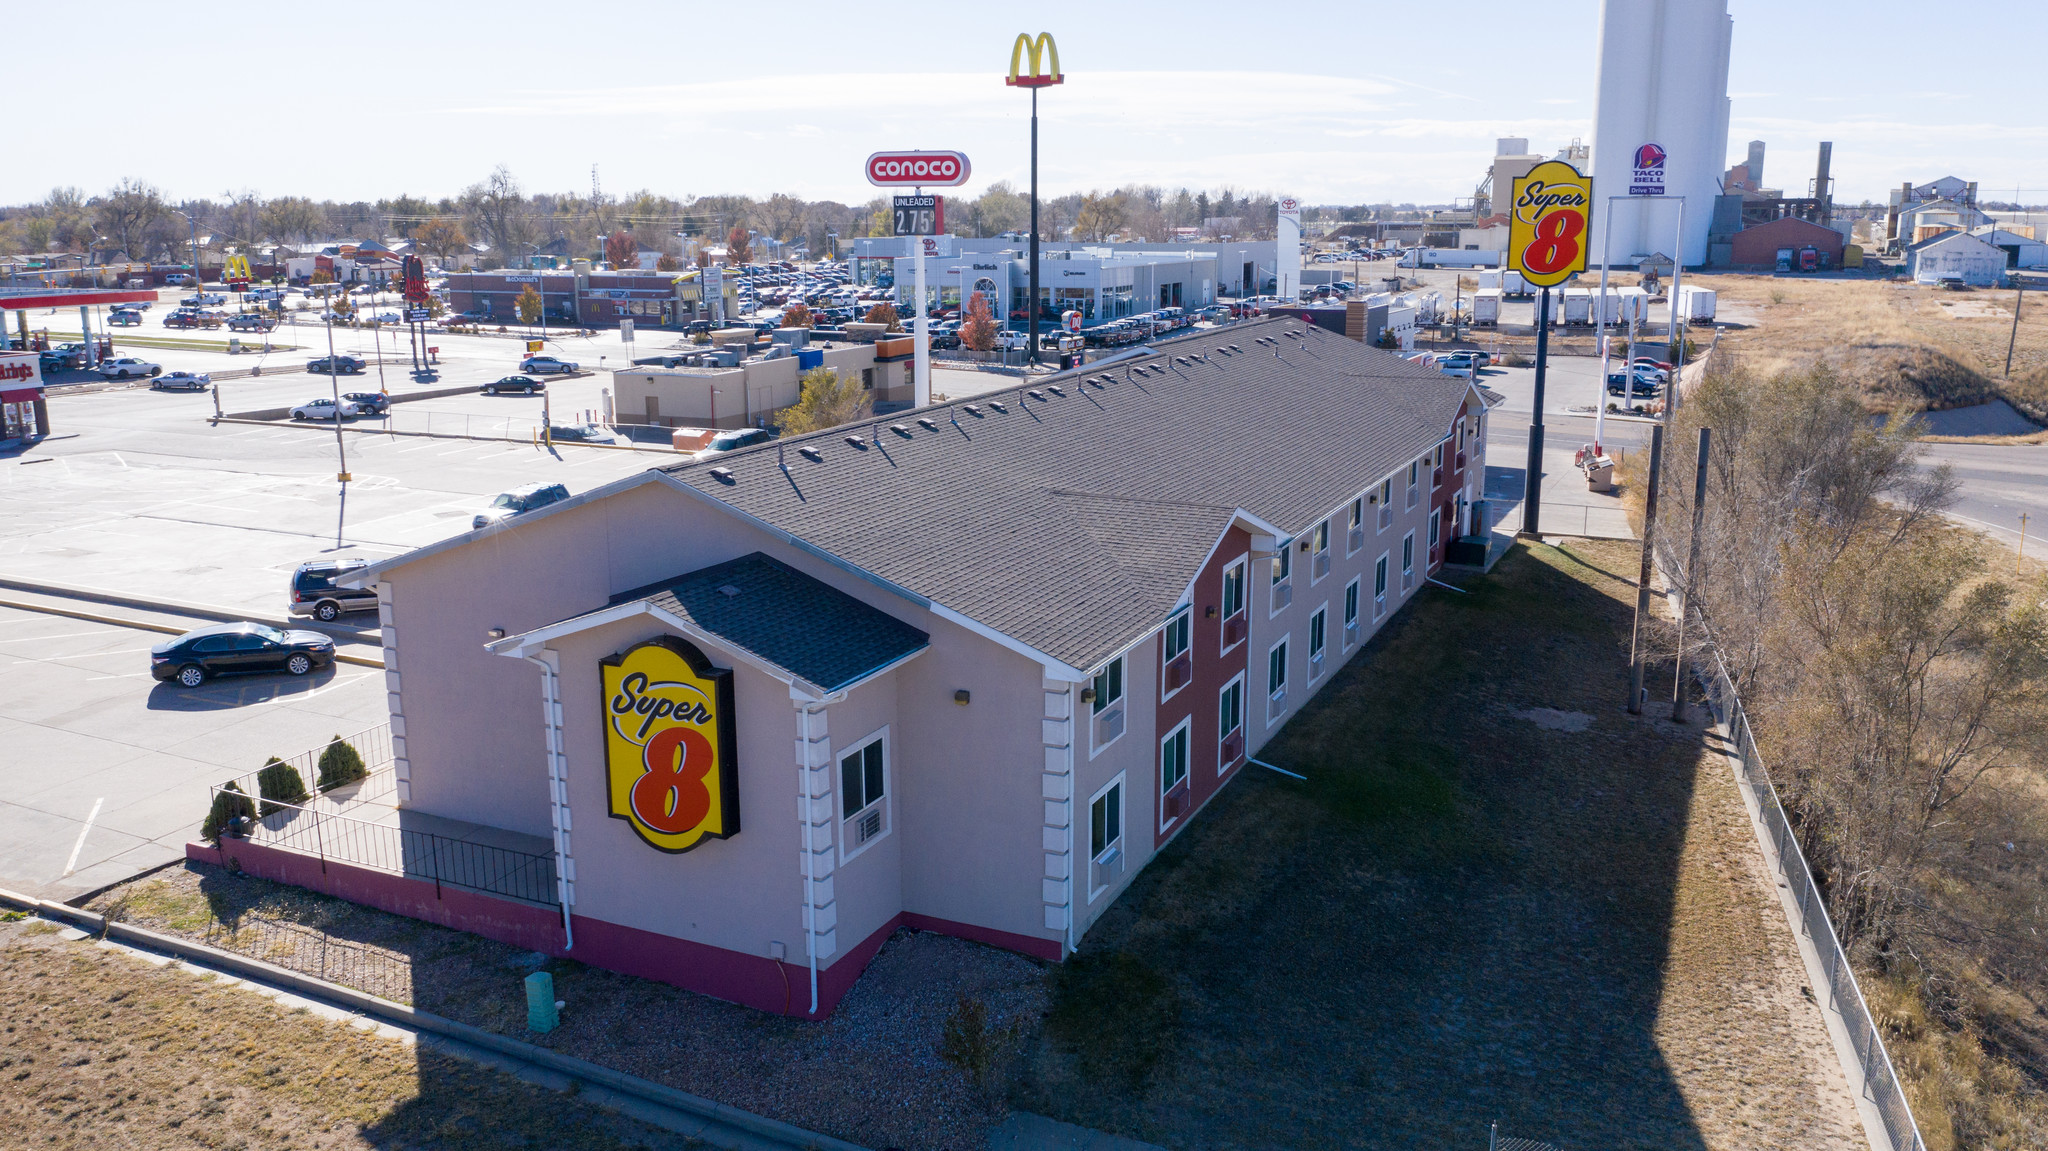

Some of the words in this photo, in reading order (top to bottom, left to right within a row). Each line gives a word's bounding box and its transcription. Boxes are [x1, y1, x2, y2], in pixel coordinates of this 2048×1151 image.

[874, 160, 956, 177] conoco
[894, 197, 935, 207] UNLEADED
[1516, 180, 1587, 220] Super
[1522, 209, 1585, 275] 8
[973, 263, 998, 271] Ehrlich
[1072, 316, 1081, 329] DQ
[610, 671, 713, 739] Super
[629, 726, 714, 835] 8
